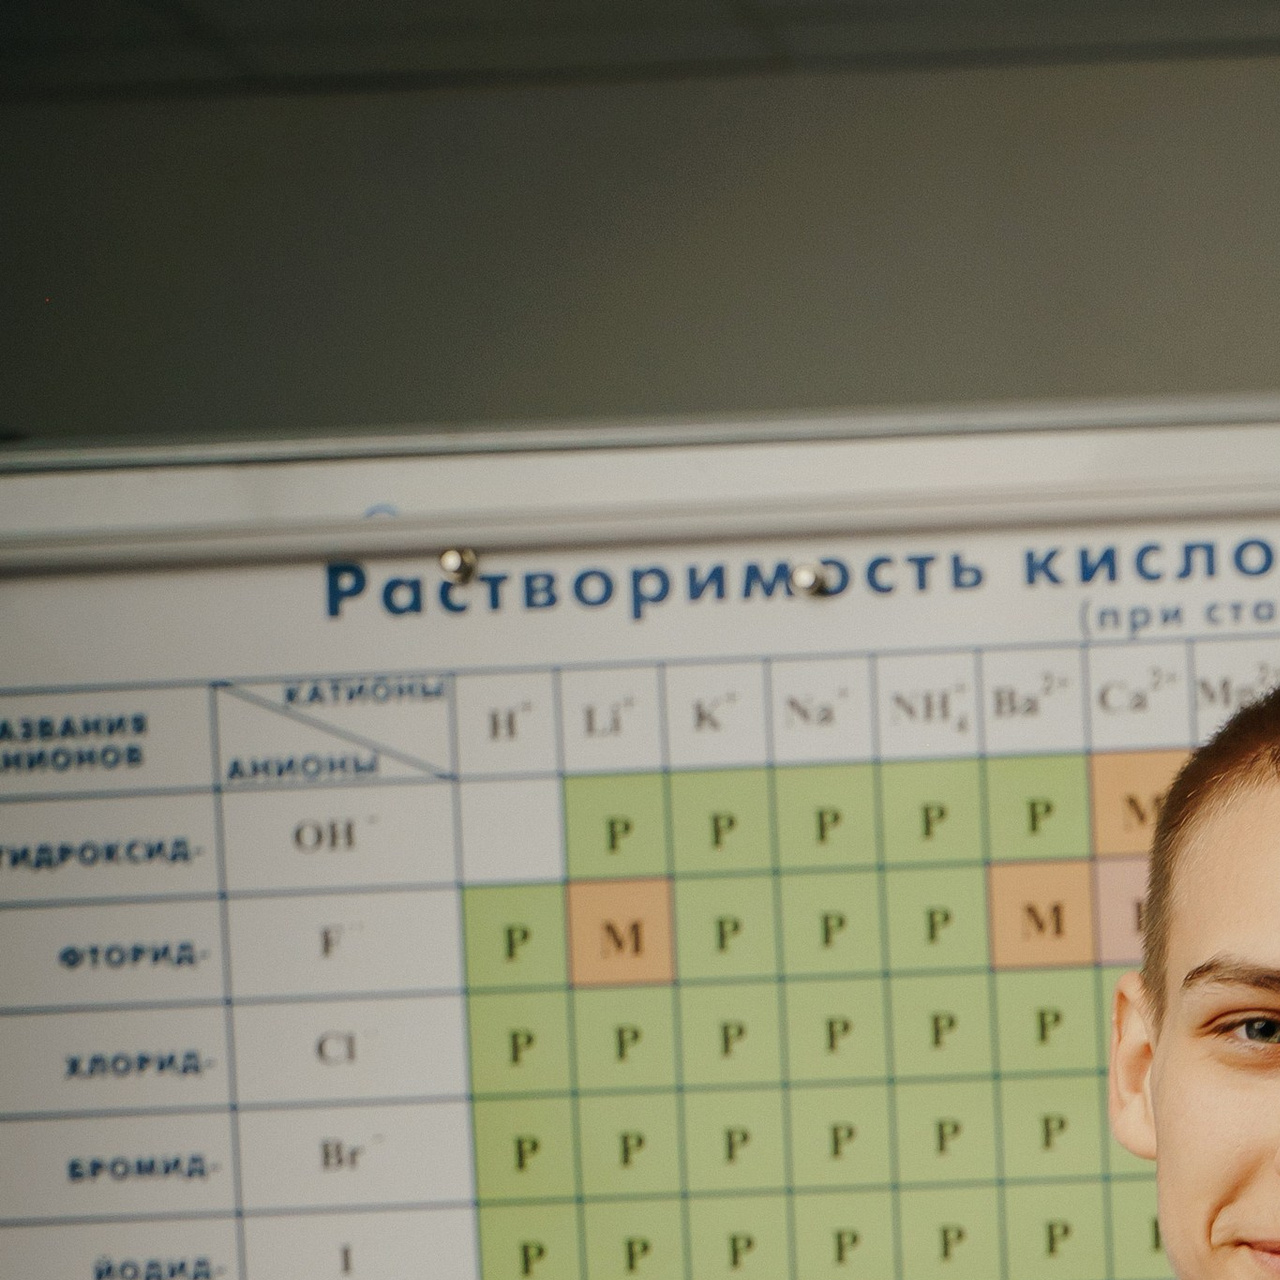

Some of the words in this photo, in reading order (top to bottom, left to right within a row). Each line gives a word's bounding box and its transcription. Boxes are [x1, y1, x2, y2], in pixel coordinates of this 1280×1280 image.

[325, 554, 985, 620] Растворимость
[1079, 600, 1183, 641] (при
[284, 680, 445, 704] КАТИОНЫ
[226, 753, 379, 783] АНИОНЫ
[606, 817, 632, 853] Р
[711, 813, 736, 848] Р
[816, 808, 841, 844] Р
[921, 804, 947, 839] Р
[1028, 799, 1054, 834] Р
[0, 839, 204, 872] ИДРОКСИД-
[504, 925, 531, 961] Р
[603, 920, 643, 956] М
[716, 917, 741, 952] Р
[821, 913, 846, 948] Р
[926, 908, 952, 944] Р
[1024, 902, 1064, 938] М
[520, 1242, 546, 1278] Р
[625, 1238, 651, 1273] Р
[729, 1234, 755, 1269] Р
[834, 1230, 860, 1265] Р
[940, 1226, 965, 1260] Р
[1046, 1221, 1071, 1256] Р
